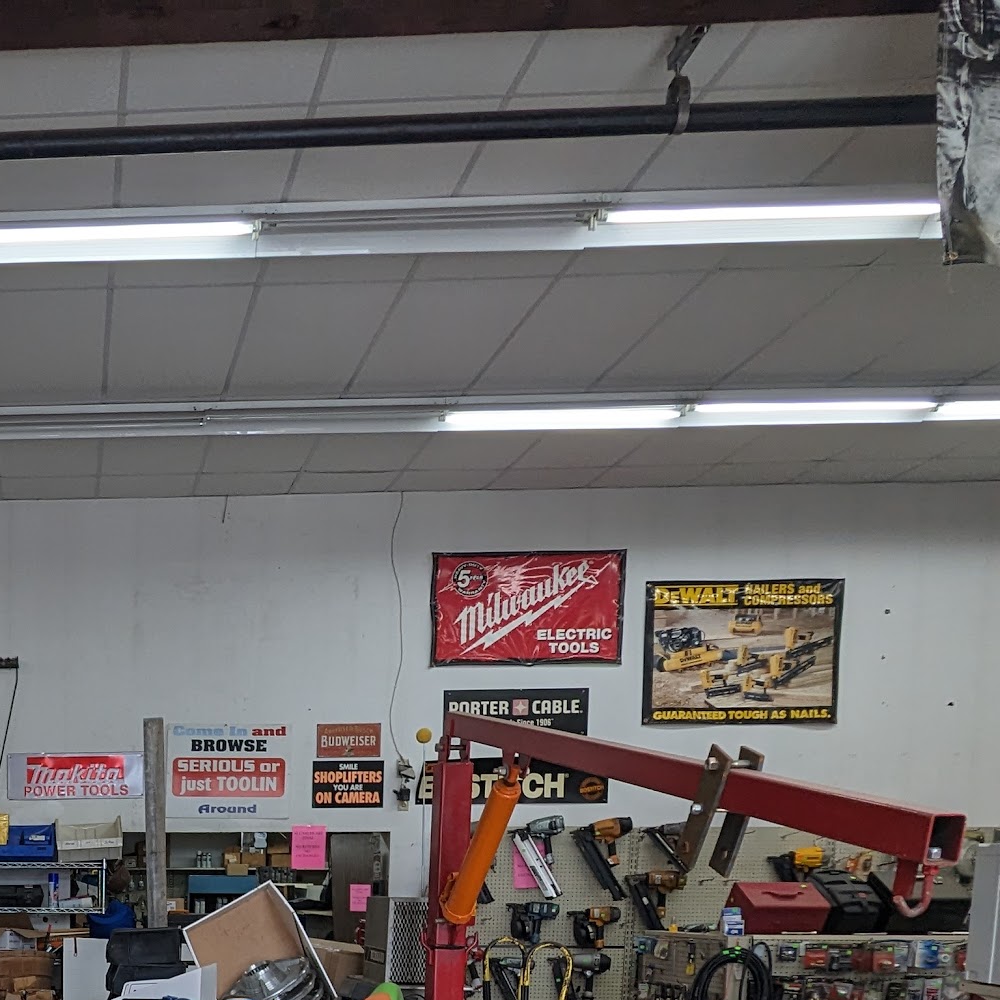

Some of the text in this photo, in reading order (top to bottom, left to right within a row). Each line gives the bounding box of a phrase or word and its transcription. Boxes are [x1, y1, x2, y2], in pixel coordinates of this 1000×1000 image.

[457, 569, 471, 588] 5
[744, 583, 795, 595] NAILERS
[799, 584, 822, 594] and
[452, 560, 591, 645] Milwaukee
[744, 594, 834, 606] COMPRESSORS
[536, 628, 613, 641] ELECTRIC
[549, 642, 600, 654] TOOLS
[448, 701, 509, 715] PORTER
[653, 709, 832, 721] GUARANTEED TOUGH AS NAILS.
[173, 725, 287, 737] Come In and
[191, 739, 267, 752] BROWSE
[321, 735, 377, 748] BUDWEISER
[178, 759, 281, 773] SERIOUS or
[314, 771, 382, 783] SHOPLIFTERS
[24, 784, 129, 797] POWER TOOLS
[180, 776, 277, 795] just TOOLIN
[315, 792, 380, 804] ON CAMERA
[198, 804, 258, 814] Around
